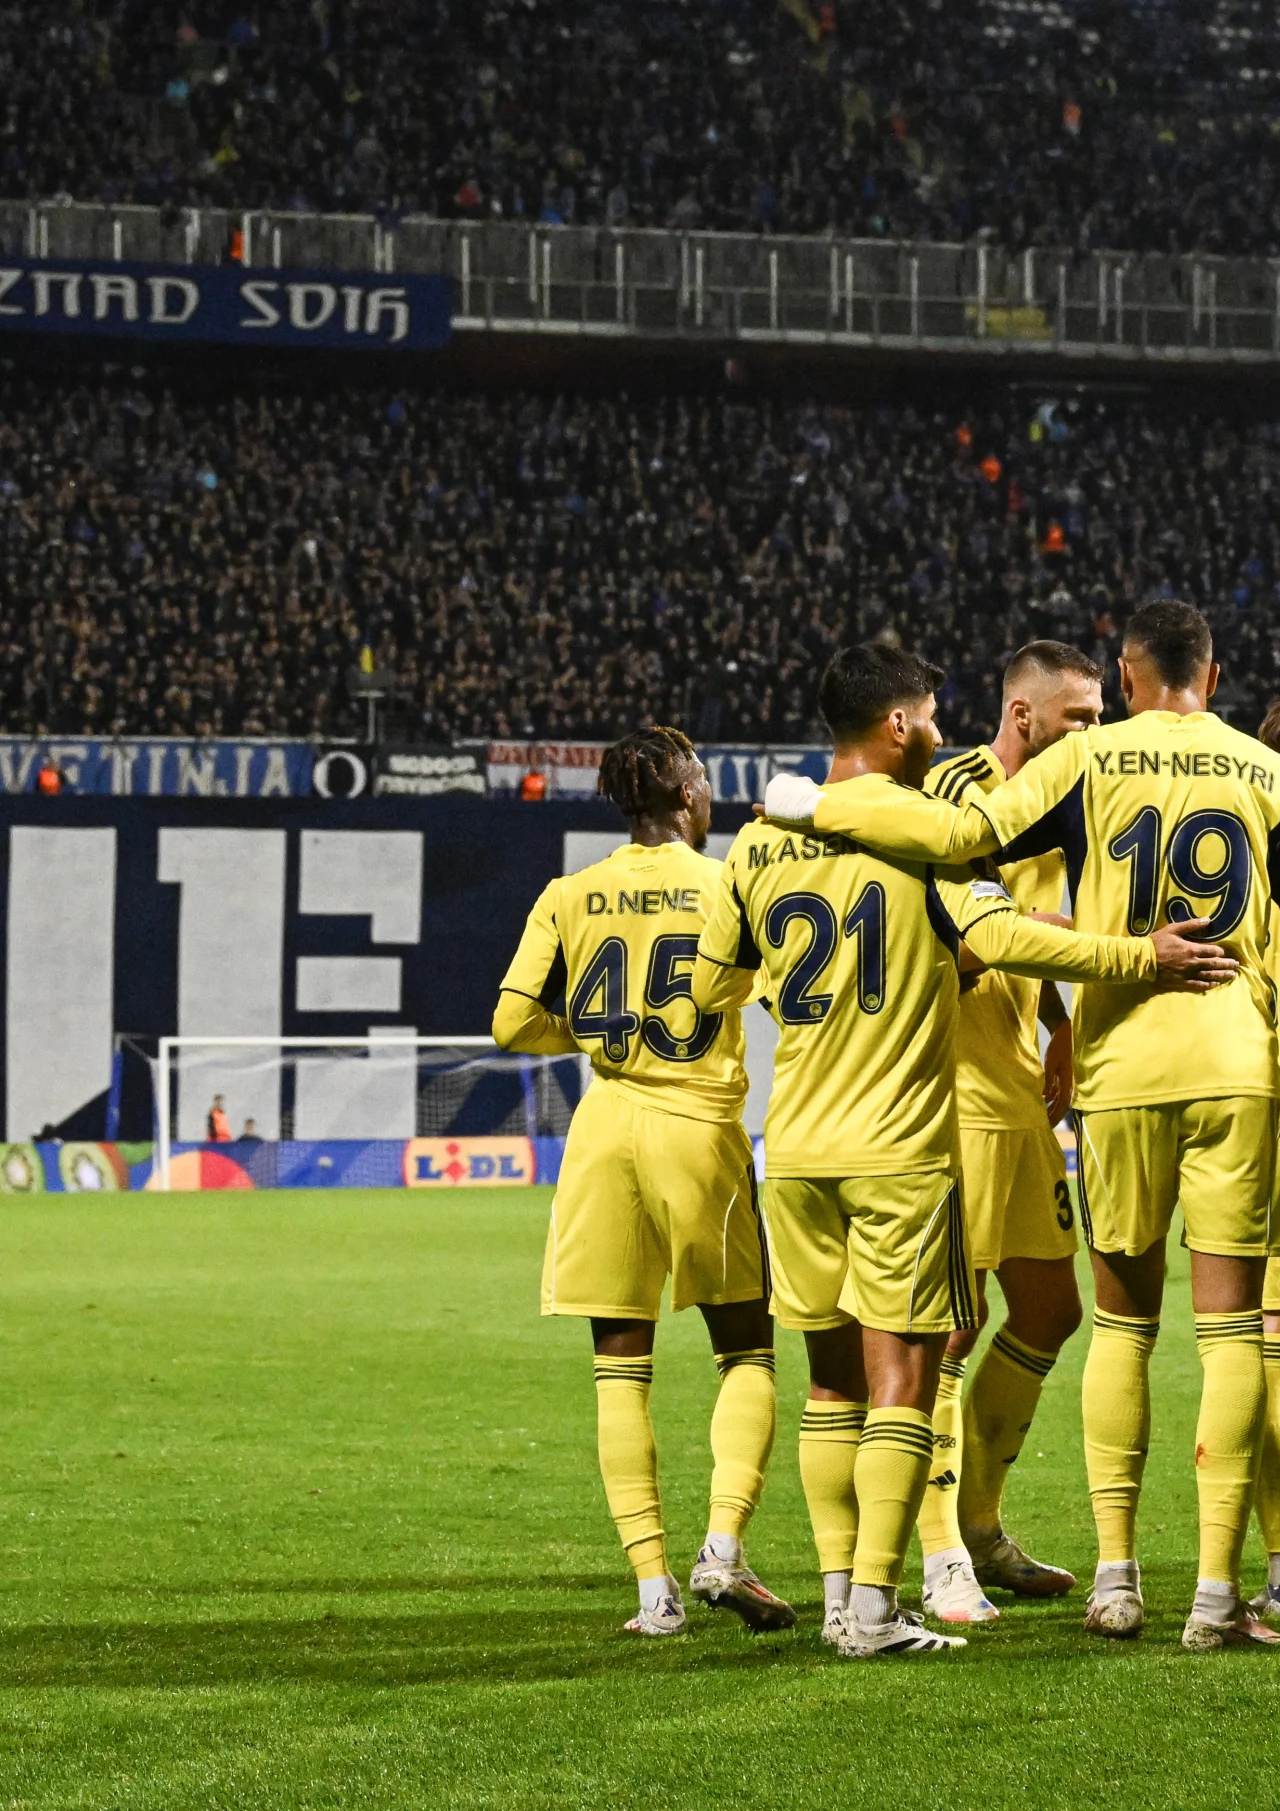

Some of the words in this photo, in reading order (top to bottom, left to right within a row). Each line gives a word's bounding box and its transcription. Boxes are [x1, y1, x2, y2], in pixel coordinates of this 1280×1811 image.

[1094, 750, 1276, 794] Y.EN-NESYRI
[748, 832, 862, 870] M.ASEN
[1108, 805, 1252, 943] 19
[569, 933, 724, 1063] 45
[765, 880, 887, 1025] 21
[1054, 1179, 1074, 1231] 3
